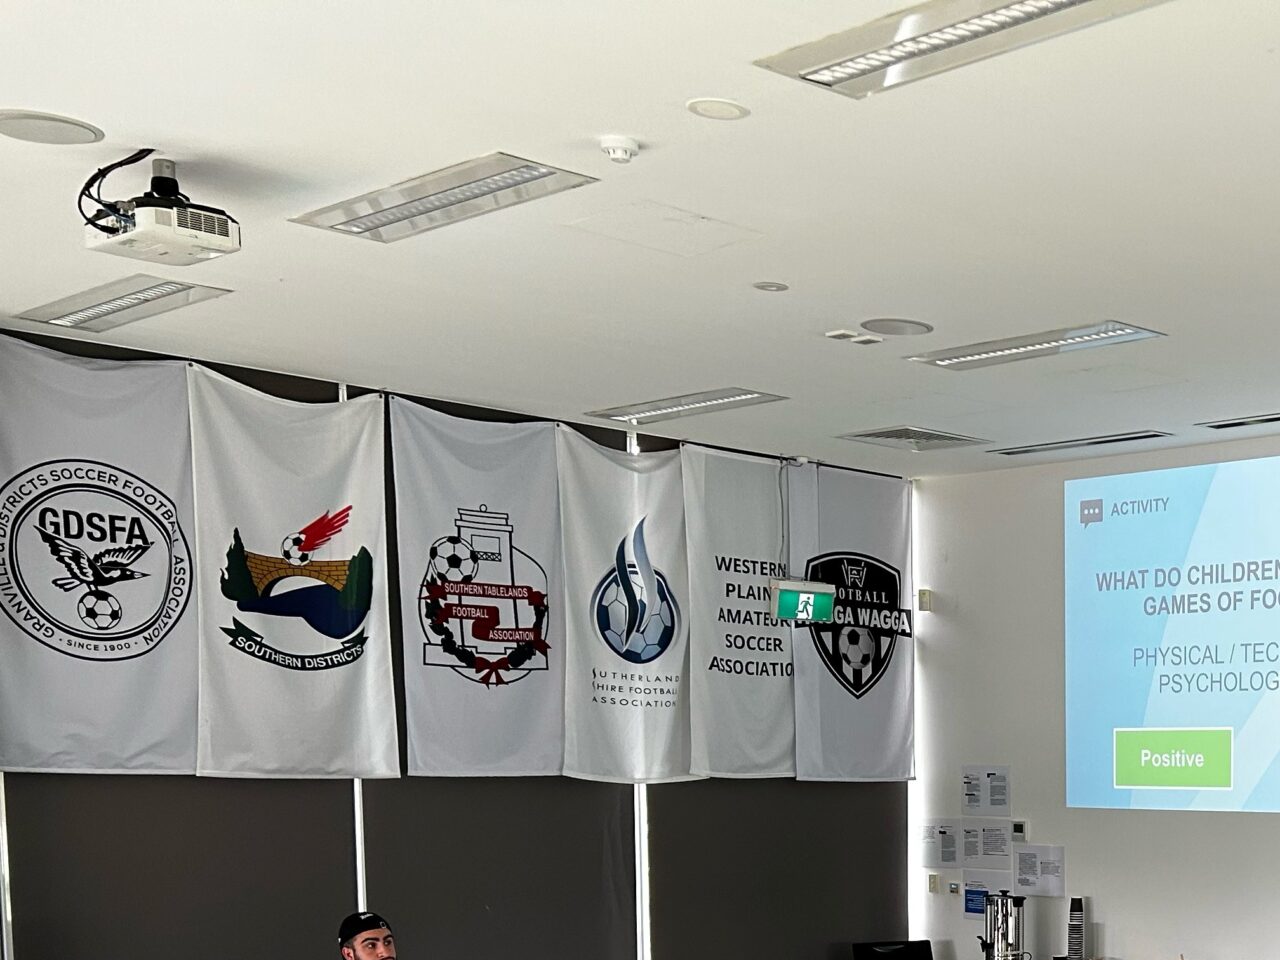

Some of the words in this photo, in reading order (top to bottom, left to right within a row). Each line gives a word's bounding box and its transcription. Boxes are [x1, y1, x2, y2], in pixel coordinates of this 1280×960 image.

[49, 467, 119, 487] SOCCER
[122, 479, 180, 549] FOOTBALL
[1110, 497, 1170, 518] ACTIVITY
[38, 507, 151, 545] GDSFA
[715, 555, 787, 578] WESTERN
[444, 582, 483, 596] SOUTHERN
[483, 585, 529, 598] TABLELANDS
[1096, 569, 1149, 592] WHAT
[1154, 567, 1182, 588] DO
[142, 554, 186, 646] ASSOCIATION
[726, 583, 772, 601] PLAIN
[452, 606, 489, 619] FOOTBALL
[1143, 592, 1212, 616] GAMES
[1217, 590, 1244, 612] OF
[857, 607, 911, 634] WAGGA
[66, 639, 100, 652] SINCE
[103, 641, 131, 652] 1900
[488, 630, 535, 641] ASSOCIATION
[725, 633, 784, 652] SOCCER
[235, 635, 301, 668] SOUTHERN
[304, 644, 364, 669] DISTRICTS
[1133, 644, 1225, 667] PHYSICAL
[1229, 643, 1236, 664] /
[592, 668, 680, 683] SUTHERLAND
[709, 656, 794, 677] ASSOCIATIO
[1140, 748, 1206, 769] Positive
